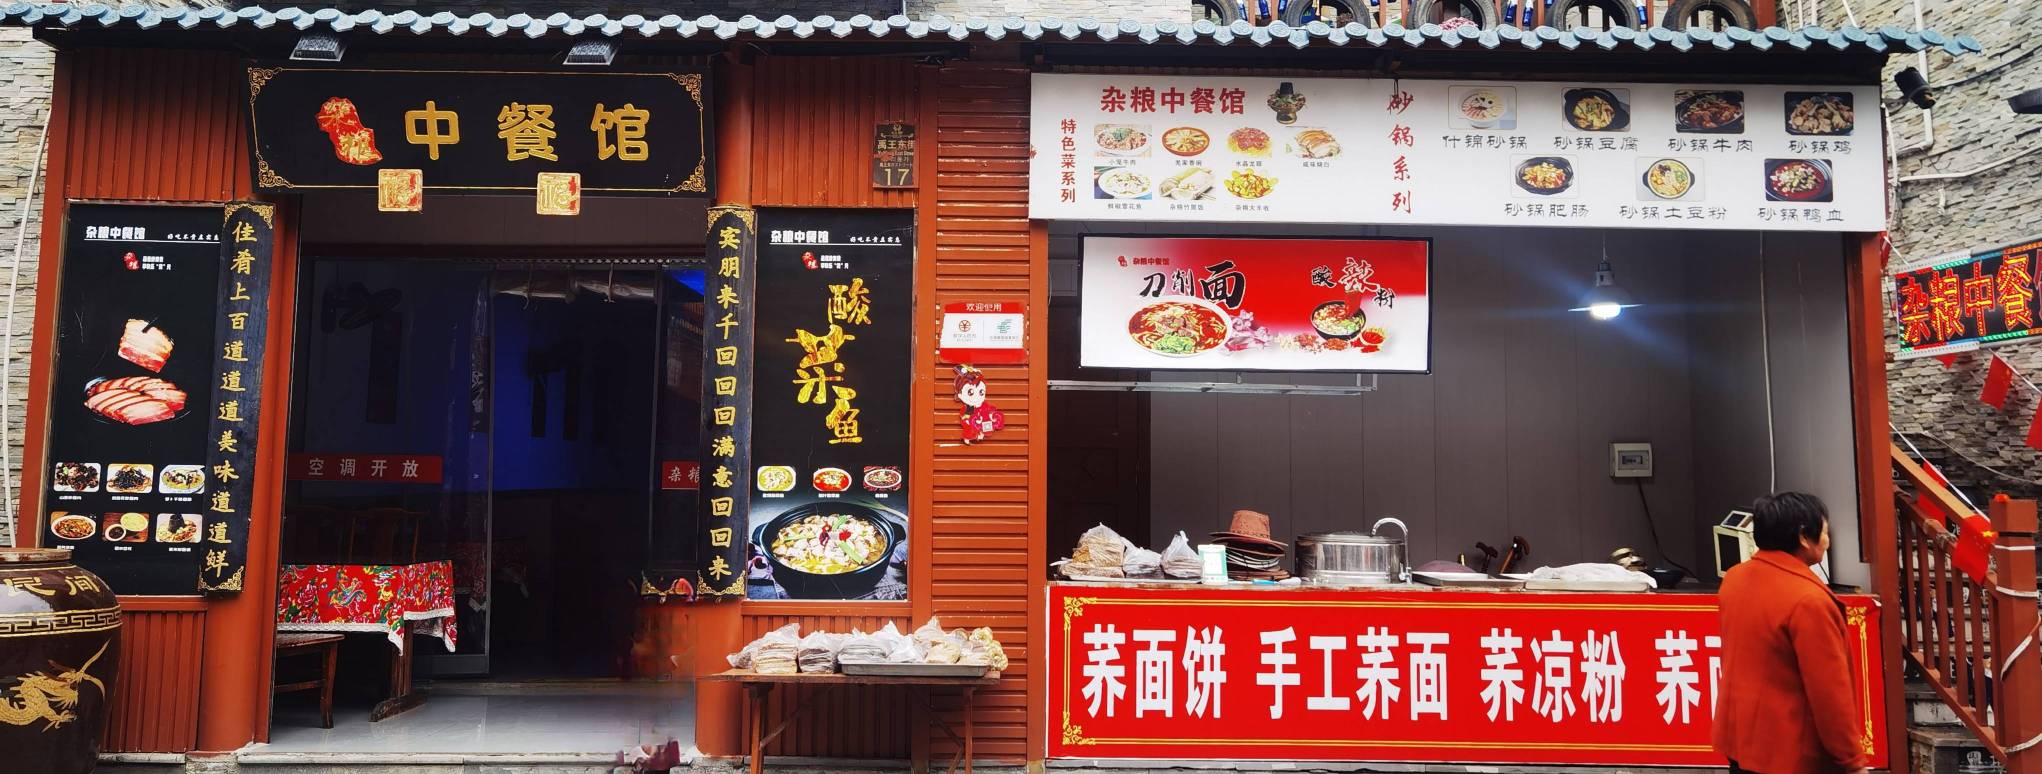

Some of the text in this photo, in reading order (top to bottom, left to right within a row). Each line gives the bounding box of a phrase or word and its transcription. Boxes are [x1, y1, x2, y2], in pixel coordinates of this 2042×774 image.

[1101, 86, 1246, 115] 杂粮中餐馆
[405, 101, 649, 161] 中餐馆
[1442, 134, 1528, 149] 什锦砂锅
[1553, 136, 1639, 151] 砂锅豆腐
[1388, 91, 1415, 213] 砂锅系列
[1667, 138, 1753, 153] 砂锅牛肉
[1788, 140, 1853, 154] 砂锅鸡
[1060, 119, 1077, 203] 特色菜系列
[884, 168, 910, 186] 17
[1504, 203, 1589, 218] 砂锅肥肠
[1619, 205, 1728, 220] 砂锅土豆粉
[1757, 207, 1845, 222] 砂锅鸭血
[1139, 260, 1246, 309] 刀削面
[1311, 256, 1396, 309] 酸辣粉
[966, 303, 1002, 312] 欢迎使用
[1901, 253, 2042, 345] 杂粮中餐
[785, 277, 872, 445] 酸菜鱼
[205, 219, 258, 577] 佳肴上百道道道美味道道鲜
[709, 226, 741, 581] 宾朋来千回回回满意回回来
[308, 457, 419, 478] 空调开放
[3, 575, 100, 597] 民间
[1082, 624, 1227, 719] 荞面饼
[1256, 626, 1450, 721] 手工荞面
[1479, 627, 1626, 724] 荞凉粉
